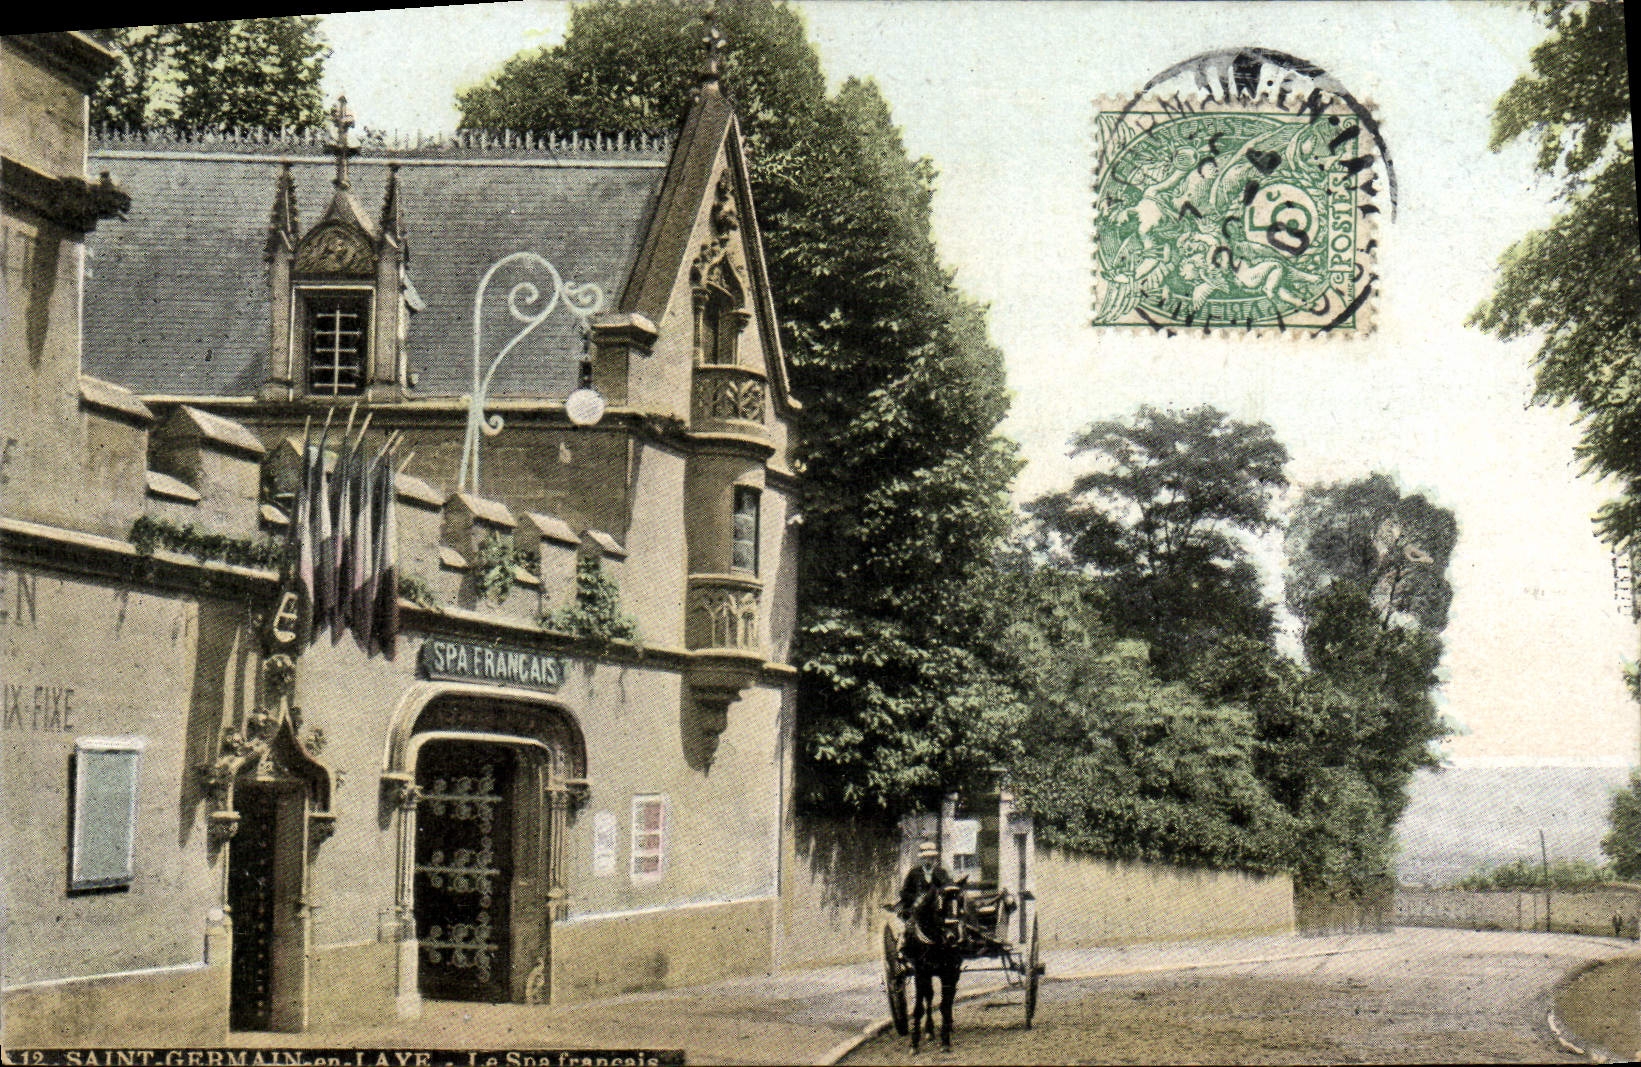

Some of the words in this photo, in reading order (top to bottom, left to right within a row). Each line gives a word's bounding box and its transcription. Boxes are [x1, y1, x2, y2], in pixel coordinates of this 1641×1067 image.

[1329, 175, 1353, 269] POSTES
[433, 640, 468, 673] SPA
[32, 686, 75, 732] FIXE
